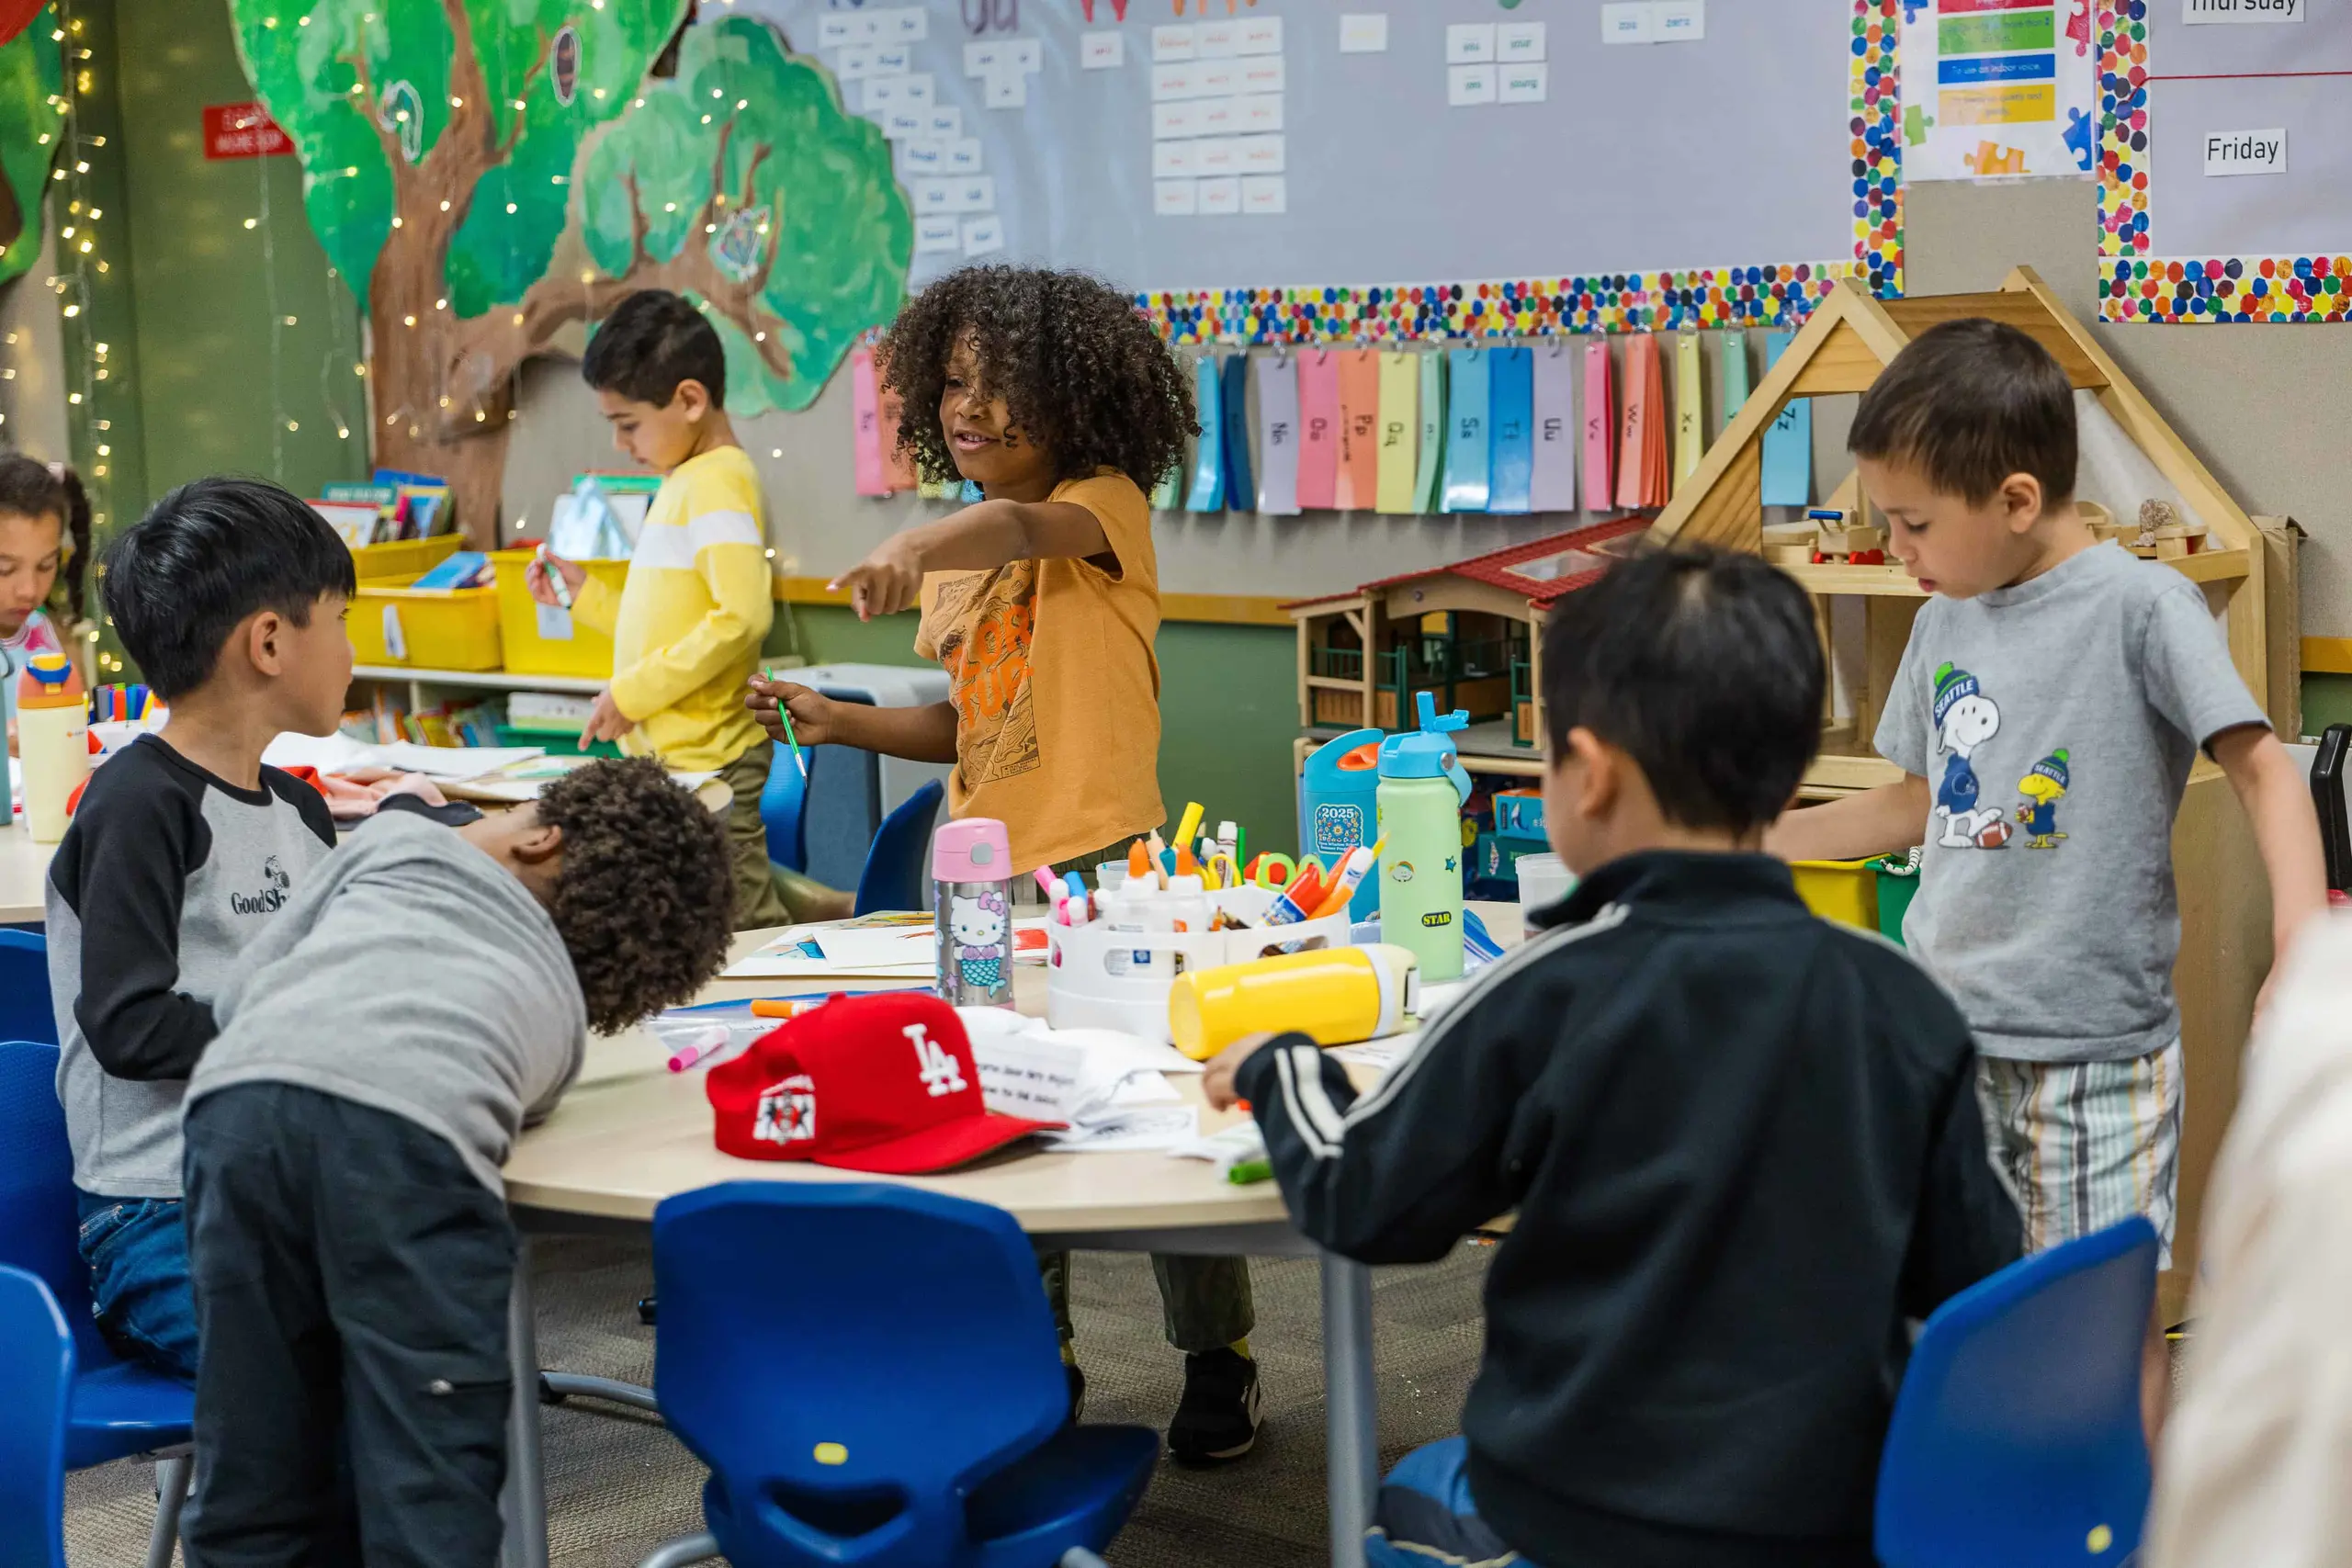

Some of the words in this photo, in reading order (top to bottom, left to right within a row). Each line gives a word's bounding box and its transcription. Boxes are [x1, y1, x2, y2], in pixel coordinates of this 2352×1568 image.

[2208, 137, 2278, 164] Friday
[1354, 414, 1374, 436] Pp
[1544, 417, 1562, 441] Uu
[1934, 679, 1974, 718] SEATTLE
[2034, 763, 2065, 784] SEATTLE
[1322, 807, 1354, 818] 2025
[231, 889, 290, 915] GoodSh
[902, 1022, 968, 1097] LA
